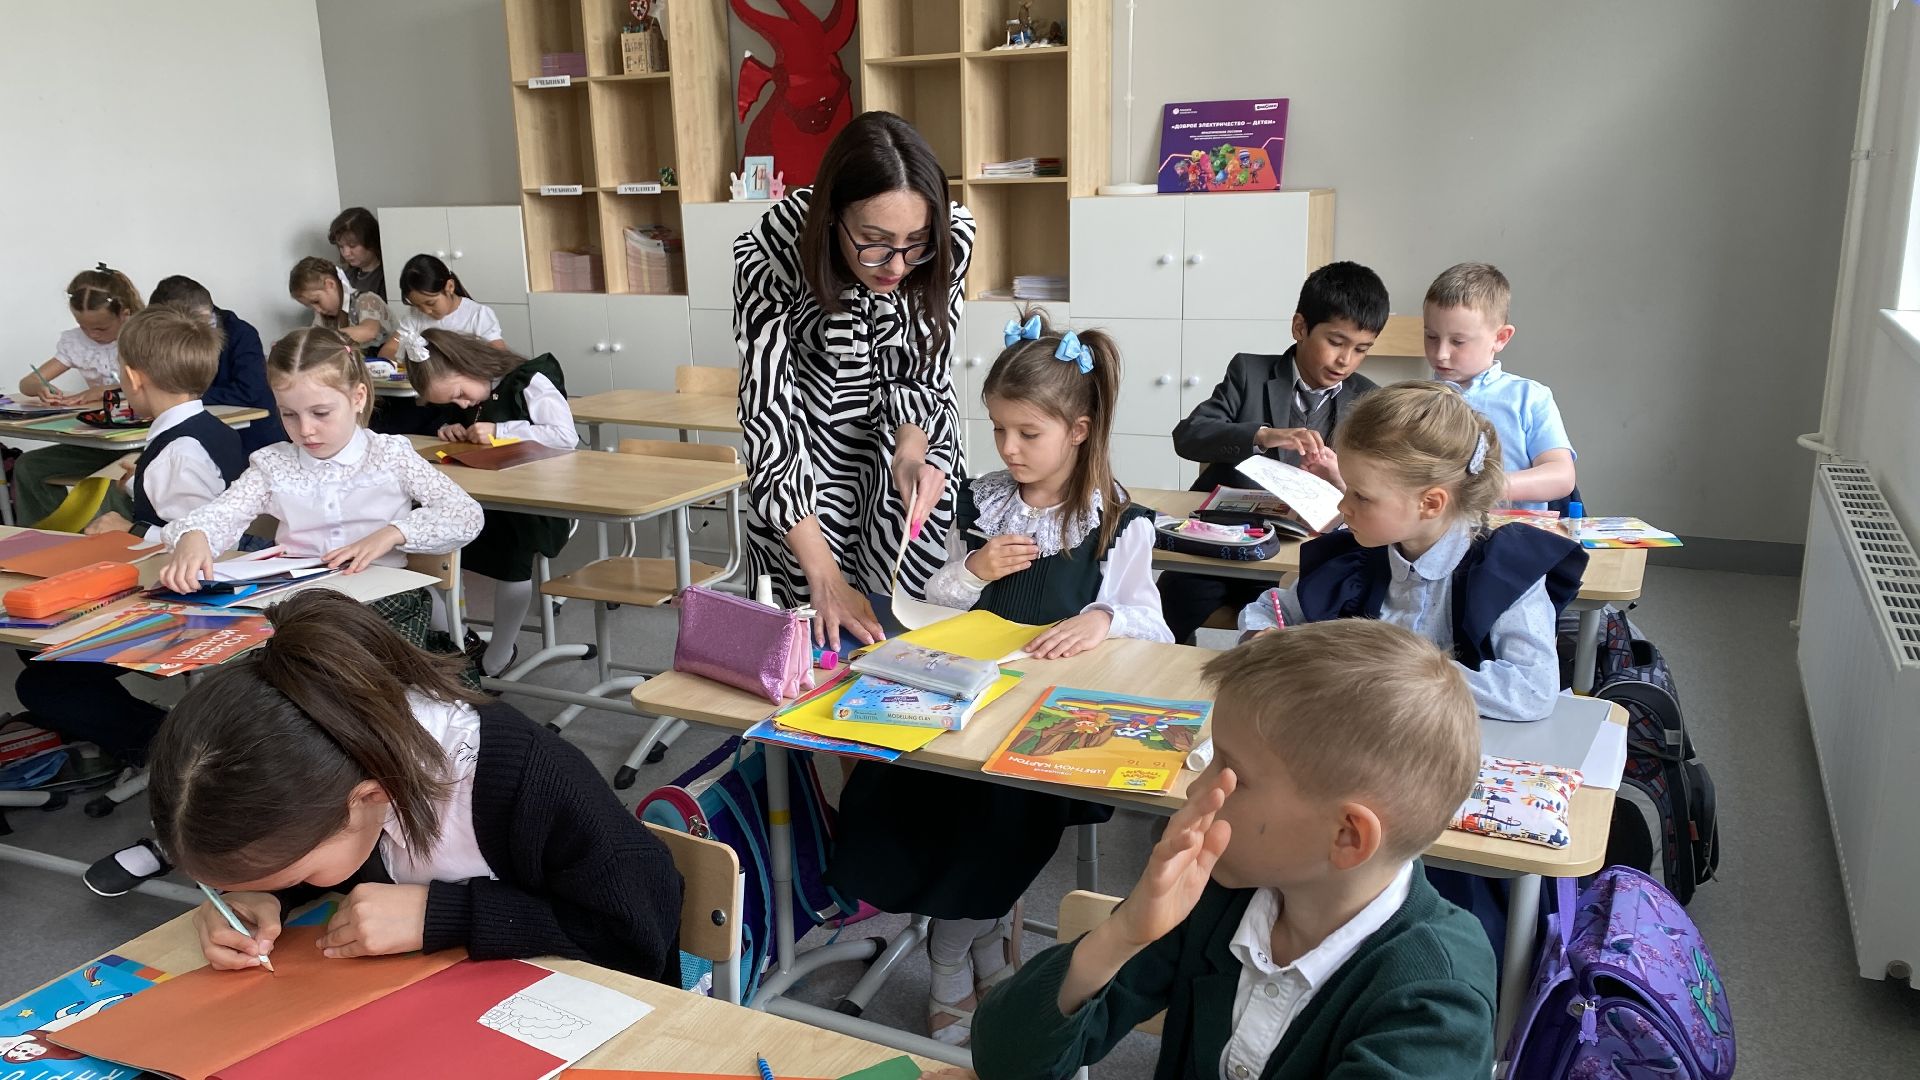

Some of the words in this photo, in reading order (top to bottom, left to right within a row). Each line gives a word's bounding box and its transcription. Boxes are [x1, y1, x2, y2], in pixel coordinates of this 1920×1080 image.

[1198, 120, 1246, 128] ЭЛЕКТРИЧЕСТВО
[171, 629, 241, 660] ЦВЕТНОЙ
[192, 634, 252, 661] КАРТОН
[1008, 756, 1051, 768] КАРТОН
